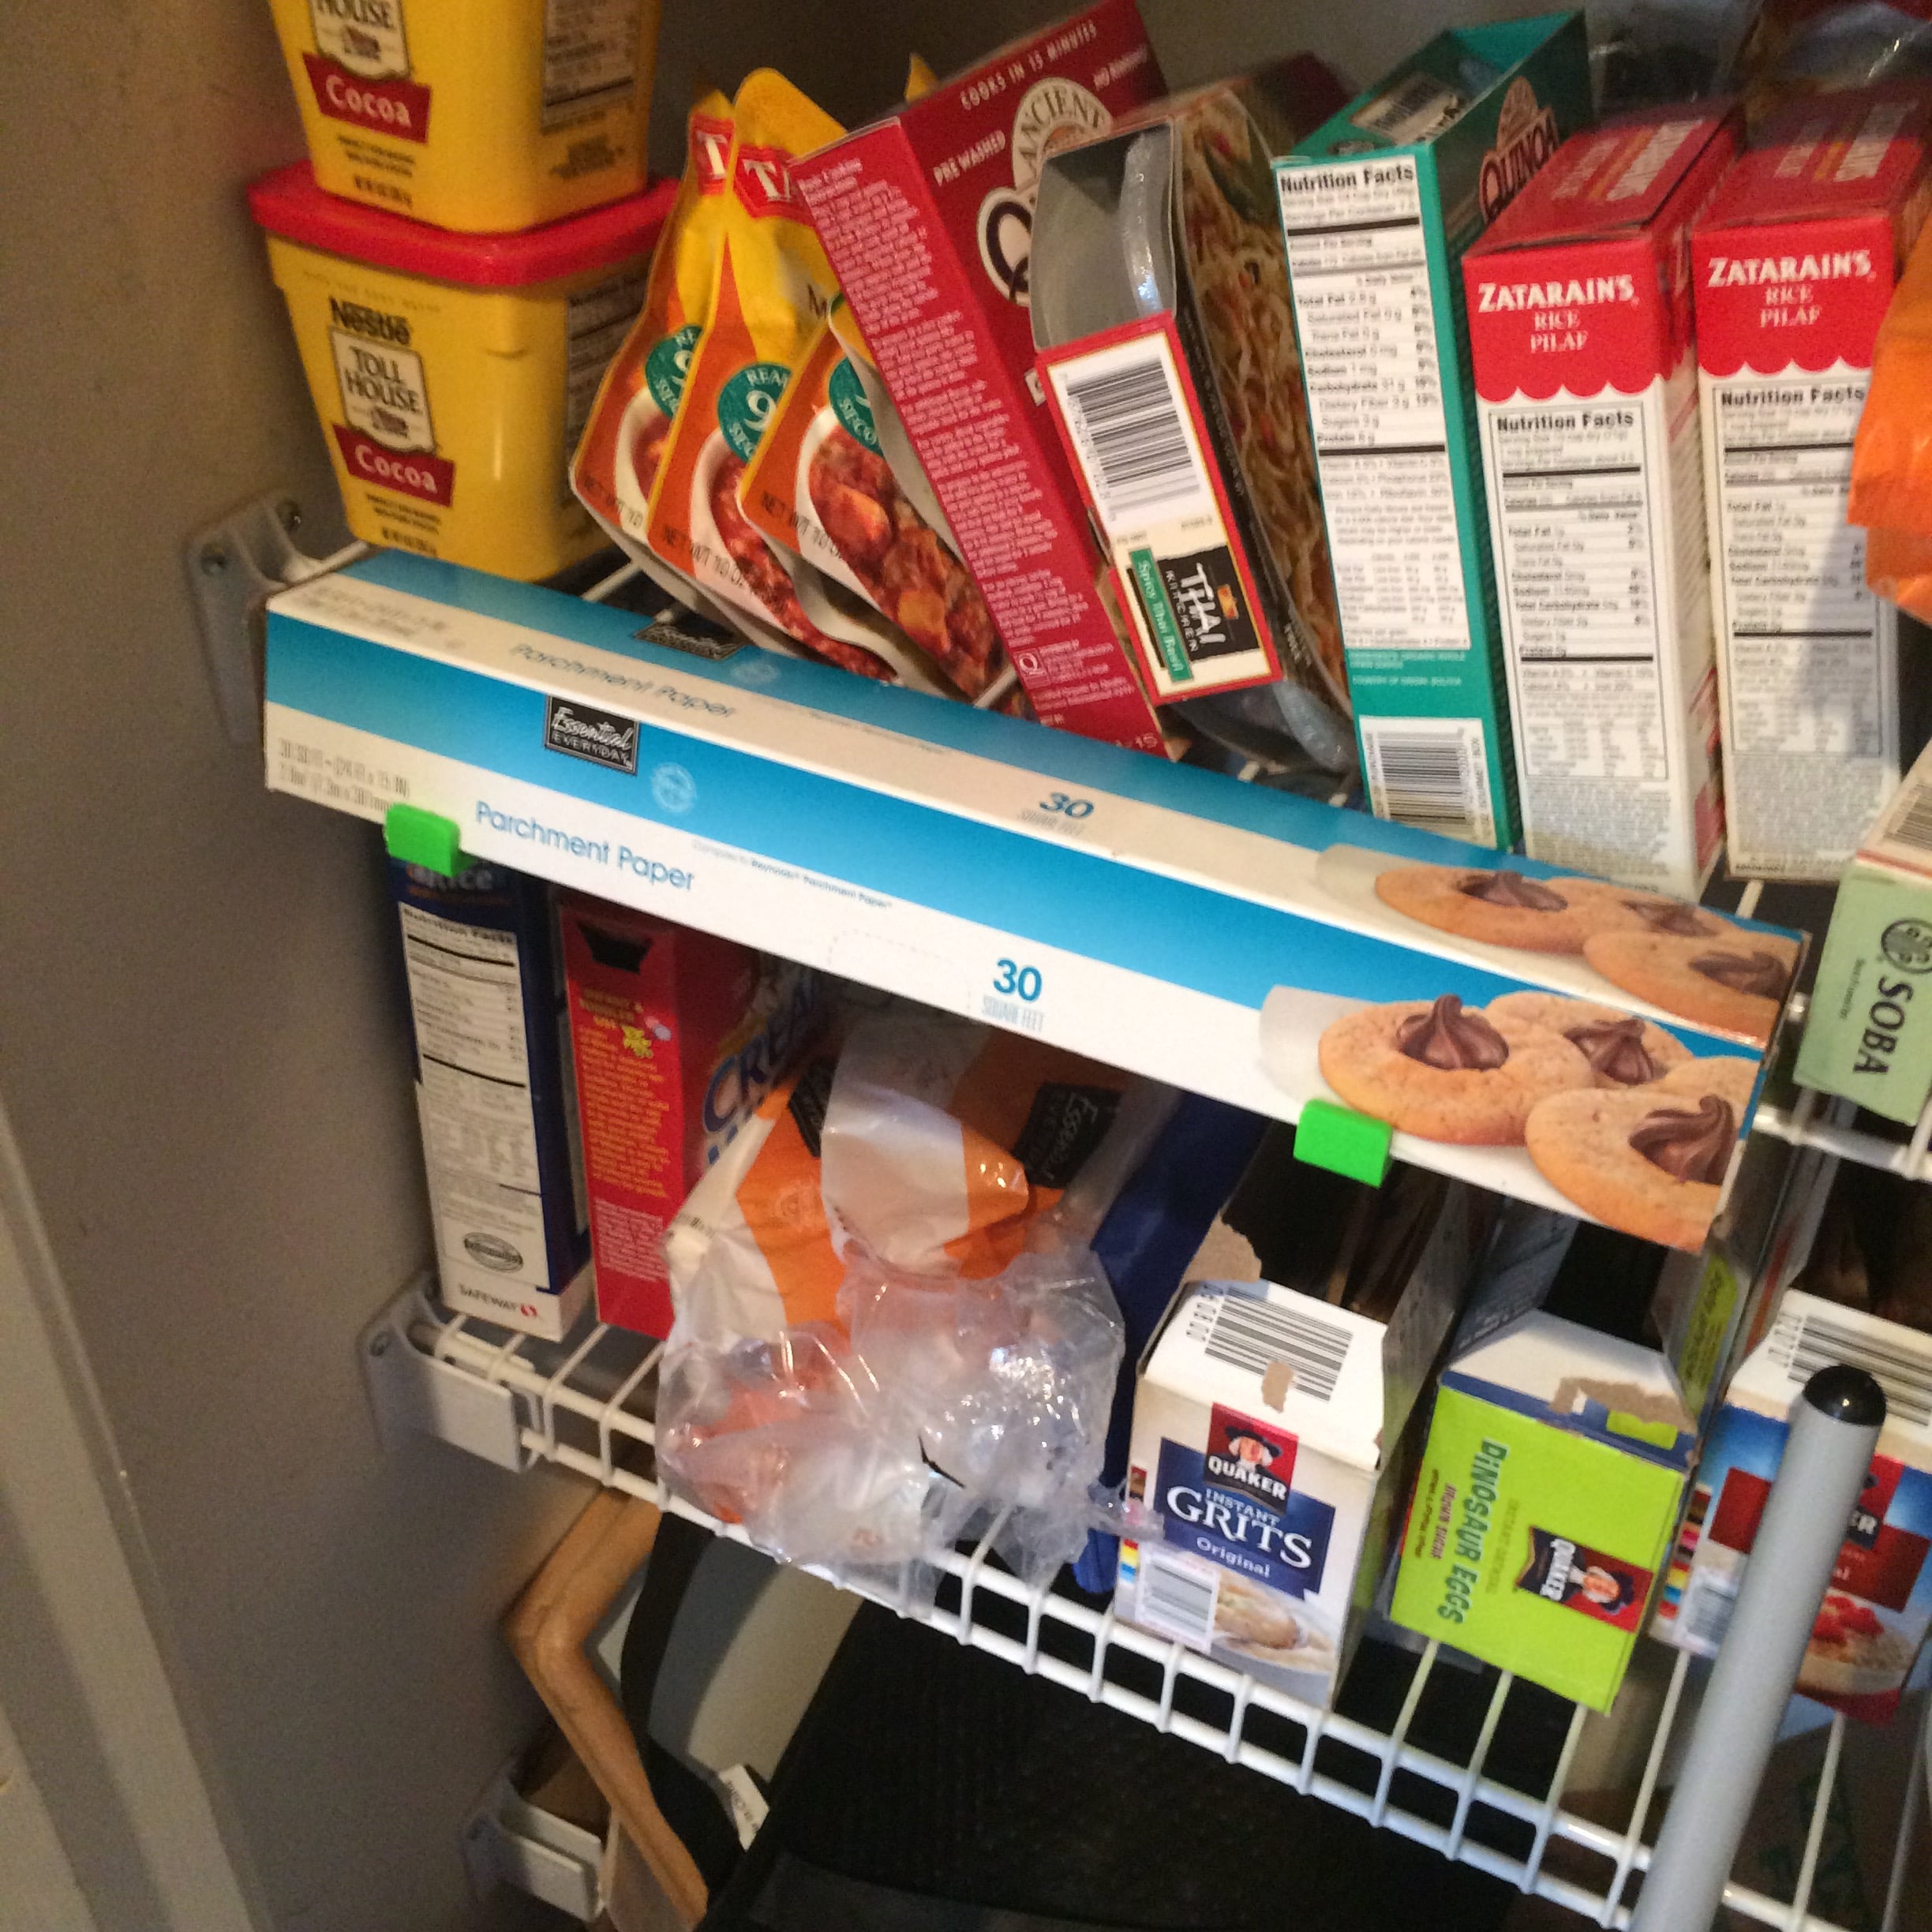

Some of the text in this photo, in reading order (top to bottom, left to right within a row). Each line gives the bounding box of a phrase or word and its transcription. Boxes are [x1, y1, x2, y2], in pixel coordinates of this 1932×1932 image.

[960, 71, 1006, 110] COOKS
[1009, 60, 1025, 84] IN
[1046, 19, 1097, 62] MINUTES
[325, 74, 411, 127] Cocoa
[1280, 163, 1414, 193] Nutrition Facts
[1765, 283, 1814, 305] RICE
[1533, 309, 1580, 331] RICE
[1759, 305, 1822, 328] PILAF
[1530, 329, 1589, 354] PILAF
[350, 346, 406, 385] TOLL
[346, 369, 419, 413] HOUSE
[1721, 385, 1865, 406] Nutrition Facts
[1496, 409, 1634, 432] Nutrition Facts
[354, 444, 438, 495] Cocoa
[1138, 560, 1157, 600] Spicy
[1165, 569, 1199, 653] KITCHEN
[1180, 562, 1226, 644] THAI
[510, 642, 654, 692] Parchment
[654, 683, 736, 717] Paper
[551, 706, 635, 751] Essential
[552, 730, 630, 765] EVERYDAY
[1039, 791, 1095, 820] 30
[475, 799, 695, 890] Parchment Paper
[992, 957, 1043, 1004] 30
[1852, 975, 1914, 1075] SOBA
[458, 1283, 519, 1312] SAFEWAY
[1208, 1455, 1289, 1501] QUAKER
[1454, 1436, 1510, 1563] DINOSAUR
[1166, 1485, 1312, 1569] GRITS
[1204, 1487, 1281, 1527] INSTANT
[1196, 1536, 1271, 1579] Original
[1436, 1563, 1478, 1625] EGGS
